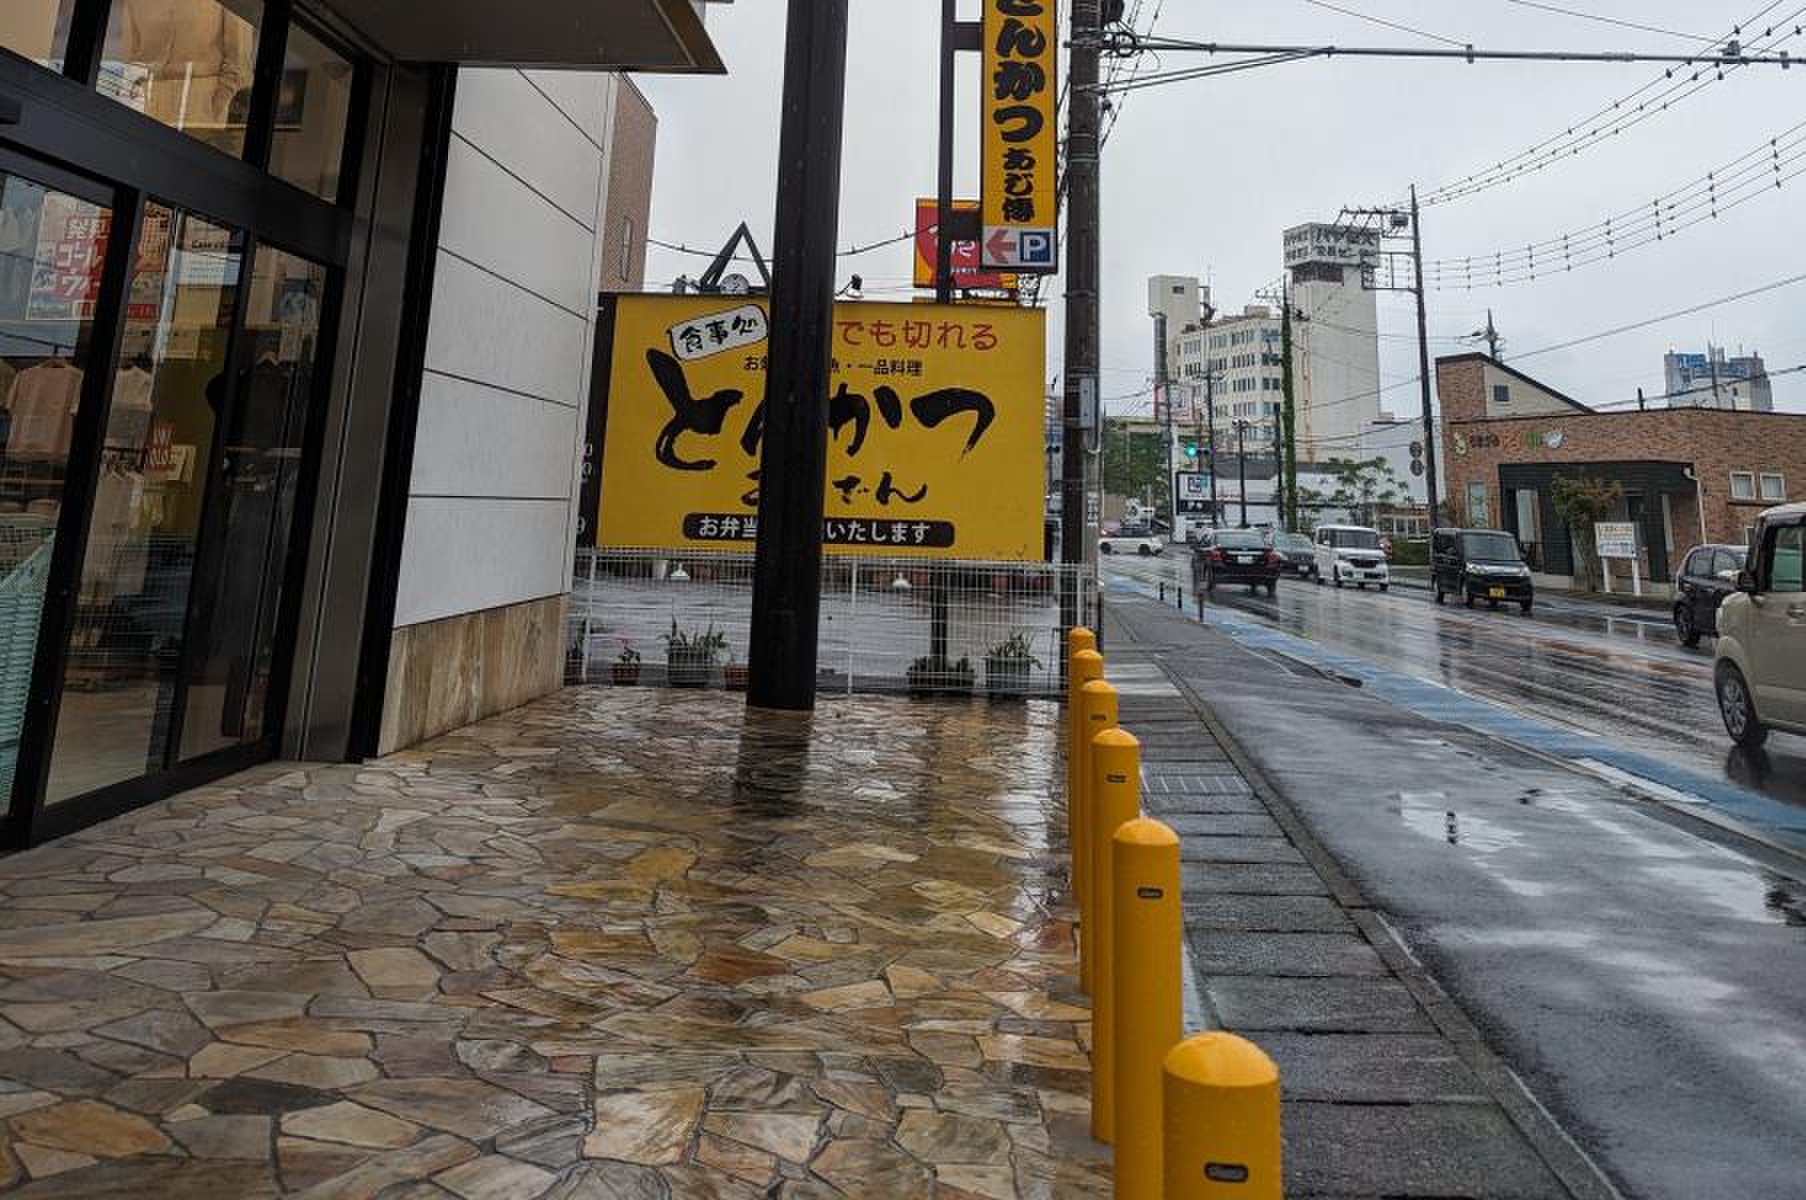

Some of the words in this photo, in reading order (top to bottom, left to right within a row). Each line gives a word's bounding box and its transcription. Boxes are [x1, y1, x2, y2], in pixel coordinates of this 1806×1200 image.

[677, 313, 758, 354] 食事処
[836, 319, 999, 351] でも切れる
